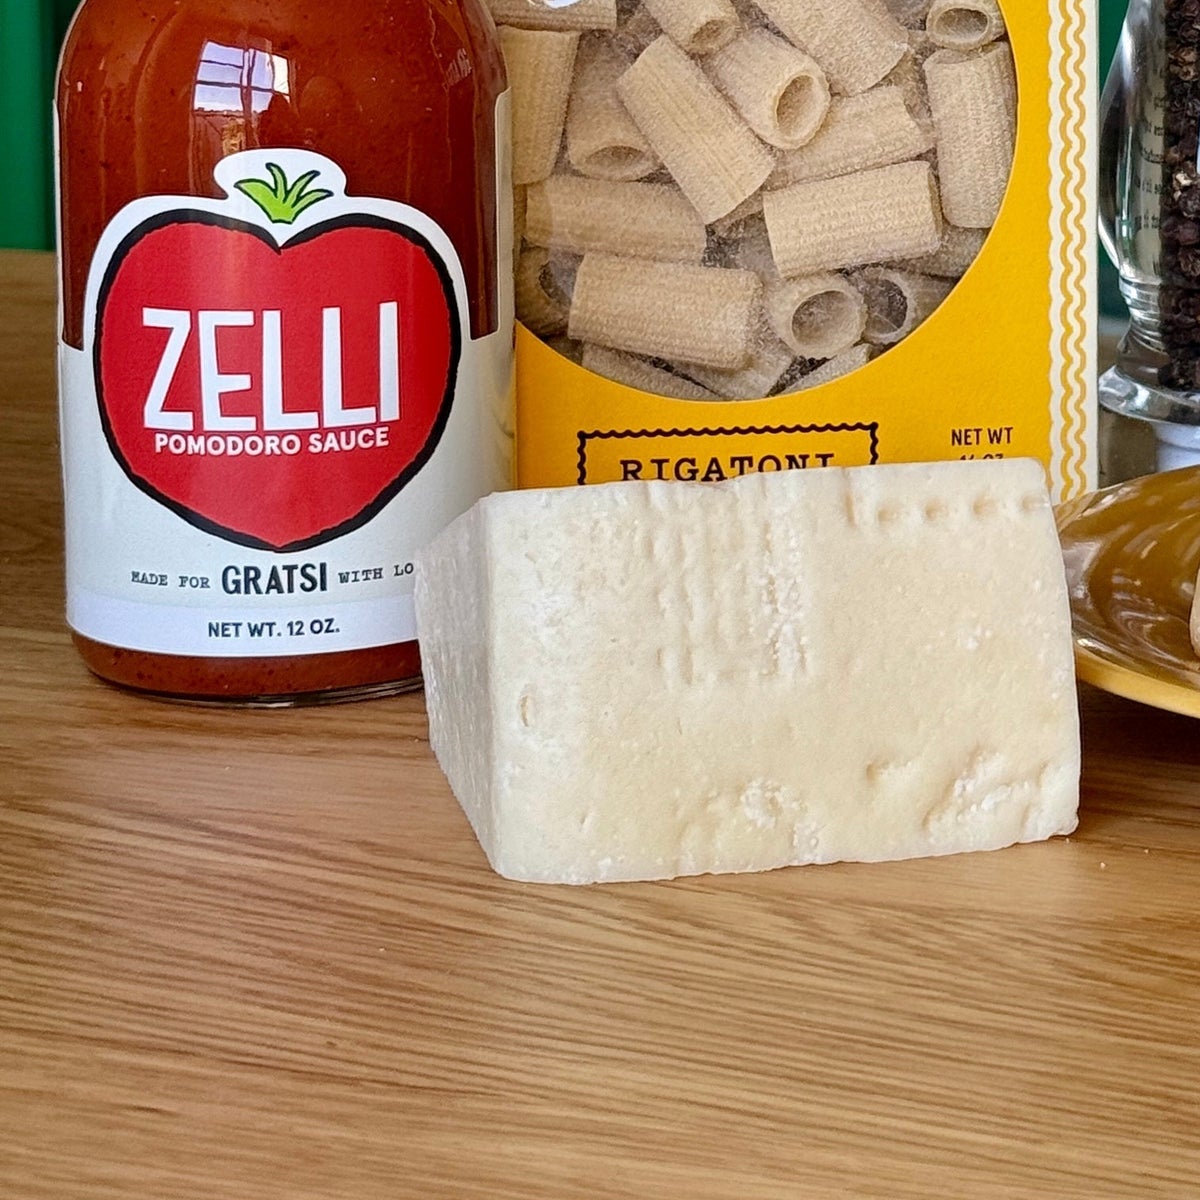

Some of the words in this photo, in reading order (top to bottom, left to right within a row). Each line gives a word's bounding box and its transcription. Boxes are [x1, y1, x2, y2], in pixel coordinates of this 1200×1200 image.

[143, 301, 400, 431] ZELLI
[154, 433, 301, 456] POMODORO
[307, 426, 389, 452] SAUCE
[951, 428, 983, 447] NET
[987, 426, 1014, 445] WT
[131, 570, 168, 587] MADE
[178, 575, 211, 589] FOR
[221, 562, 328, 595] GRATSI
[337, 567, 384, 584] WITH
[393, 562, 414, 577] LO
[208, 621, 243, 638] NET
[247, 621, 282, 638] WT.
[286, 620, 305, 637] 12
[309, 617, 340, 635] OZ.
